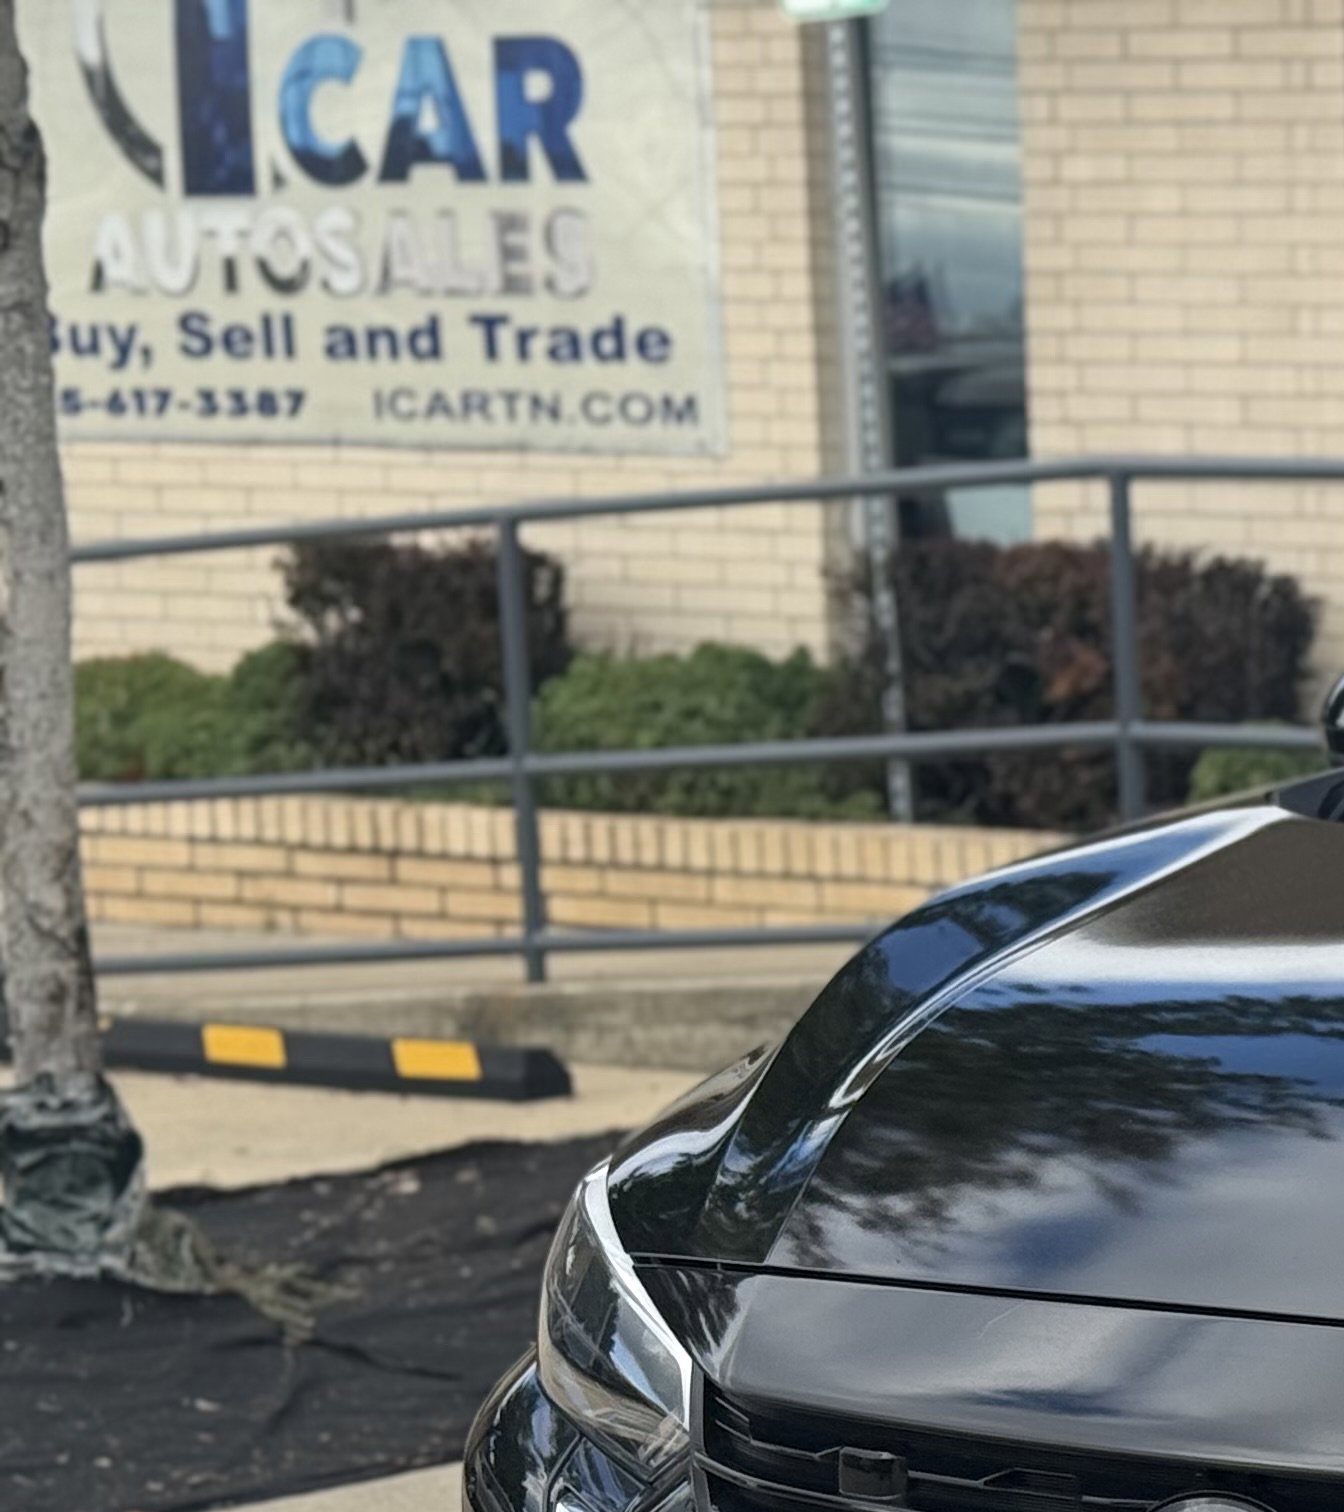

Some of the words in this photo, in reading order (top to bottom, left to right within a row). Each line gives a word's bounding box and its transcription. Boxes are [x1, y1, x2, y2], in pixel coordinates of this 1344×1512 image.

[90, 206, 593, 299] AUTOSALES
[178, 310, 296, 359] Sell
[324, 313, 443, 362] and
[469, 313, 673, 364] Trade
[373, 386, 699, 426] ICARTN.COM
